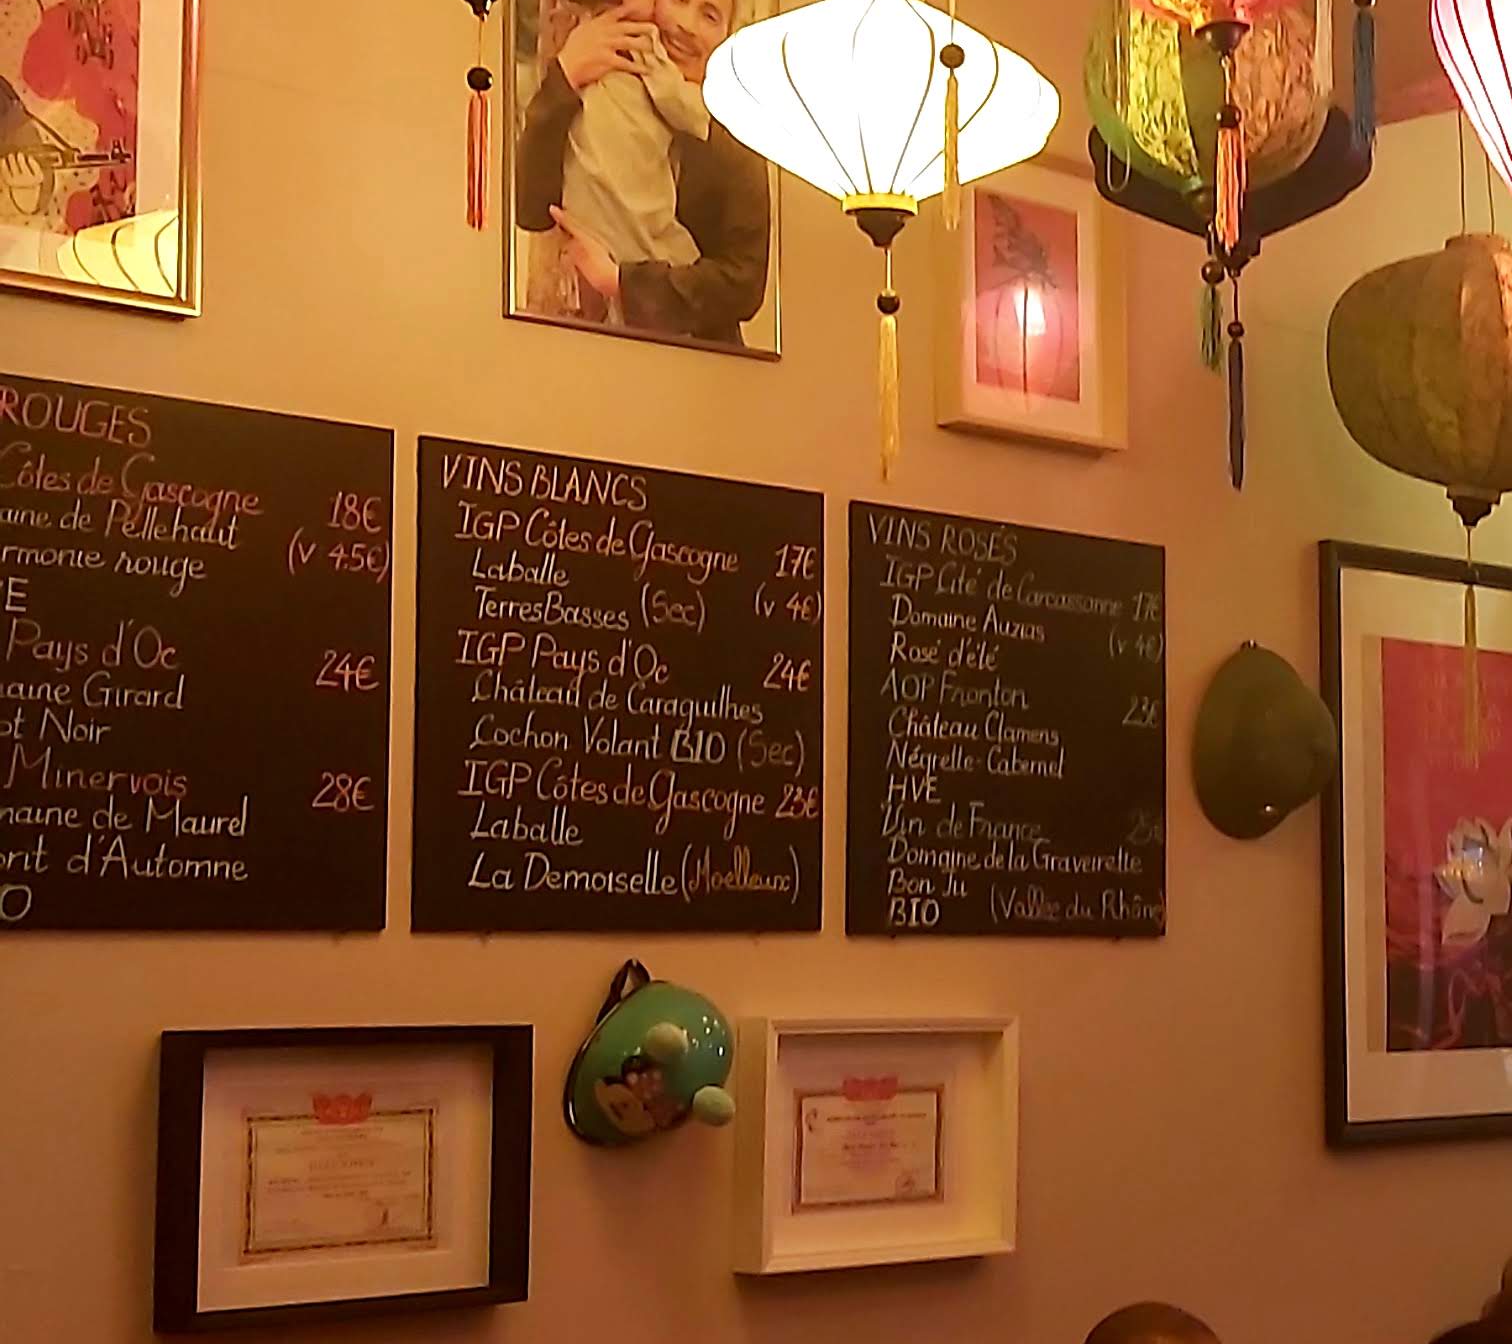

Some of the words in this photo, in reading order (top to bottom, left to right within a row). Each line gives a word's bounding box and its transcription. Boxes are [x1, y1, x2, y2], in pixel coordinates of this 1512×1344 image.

[77, 456, 113, 495] de
[121, 452, 264, 526] Gascogne
[327, 491, 382, 533] 18€
[442, 454, 523, 497] VINS
[530, 464, 647, 511] BLANCS
[59, 498, 94, 532] de
[104, 498, 240, 551] Pellehaut
[454, 500, 521, 542] IGP
[524, 507, 593, 553] Côtes
[596, 515, 626, 557] de
[629, 519, 740, 586] Gascogne
[775, 543, 817, 580] 17€
[869, 512, 930, 550] VINS
[114, 552, 207, 597] rouge
[471, 546, 571, 588] Laballe
[879, 553, 935, 592] IGP
[987, 568, 1013, 601] de
[0, 576, 29, 612] E
[641, 581, 706, 634] (Sec)
[888, 593, 978, 632] Domaine
[6, 616, 88, 672] Pays
[102, 619, 179, 670] d'Oc
[315, 649, 380, 692] 24€
[455, 629, 526, 667] IGP
[531, 632, 600, 689] Pays
[608, 637, 669, 684] d'Oc
[763, 651, 812, 692] 24€
[889, 631, 942, 664] Rosé
[0, 682, 72, 705] aine
[83, 670, 185, 710] Girard
[588, 678, 620, 711] de
[880, 666, 935, 703] AOP
[939, 669, 1030, 709] Fronton
[39, 707, 112, 744] Noir
[469, 709, 570, 752] Cochon
[584, 715, 663, 759] Volant
[670, 728, 726, 764] BIO
[888, 706, 979, 739] Château
[985, 709, 1060, 746] Clamens
[3, 742, 188, 797] Minervois
[311, 772, 375, 813] 28€
[457, 759, 532, 799] IGP
[536, 756, 609, 805] Côtes
[612, 763, 646, 806] de
[648, 768, 765, 840] Gascogne
[887, 773, 941, 804] HVE
[92, 793, 133, 830] de
[145, 795, 248, 838] Maurel
[470, 800, 583, 846] Laballe
[936, 802, 963, 838] de
[969, 801, 1041, 840] France
[67, 833, 249, 881] d'Automne
[468, 851, 515, 891] La
[523, 848, 678, 894] Demoiselle
[887, 836, 981, 869] Domaine
[984, 839, 1004, 870] de
[1008, 839, 1030, 872] la
[888, 867, 935, 896] Bon
[889, 896, 940, 928] BIO
